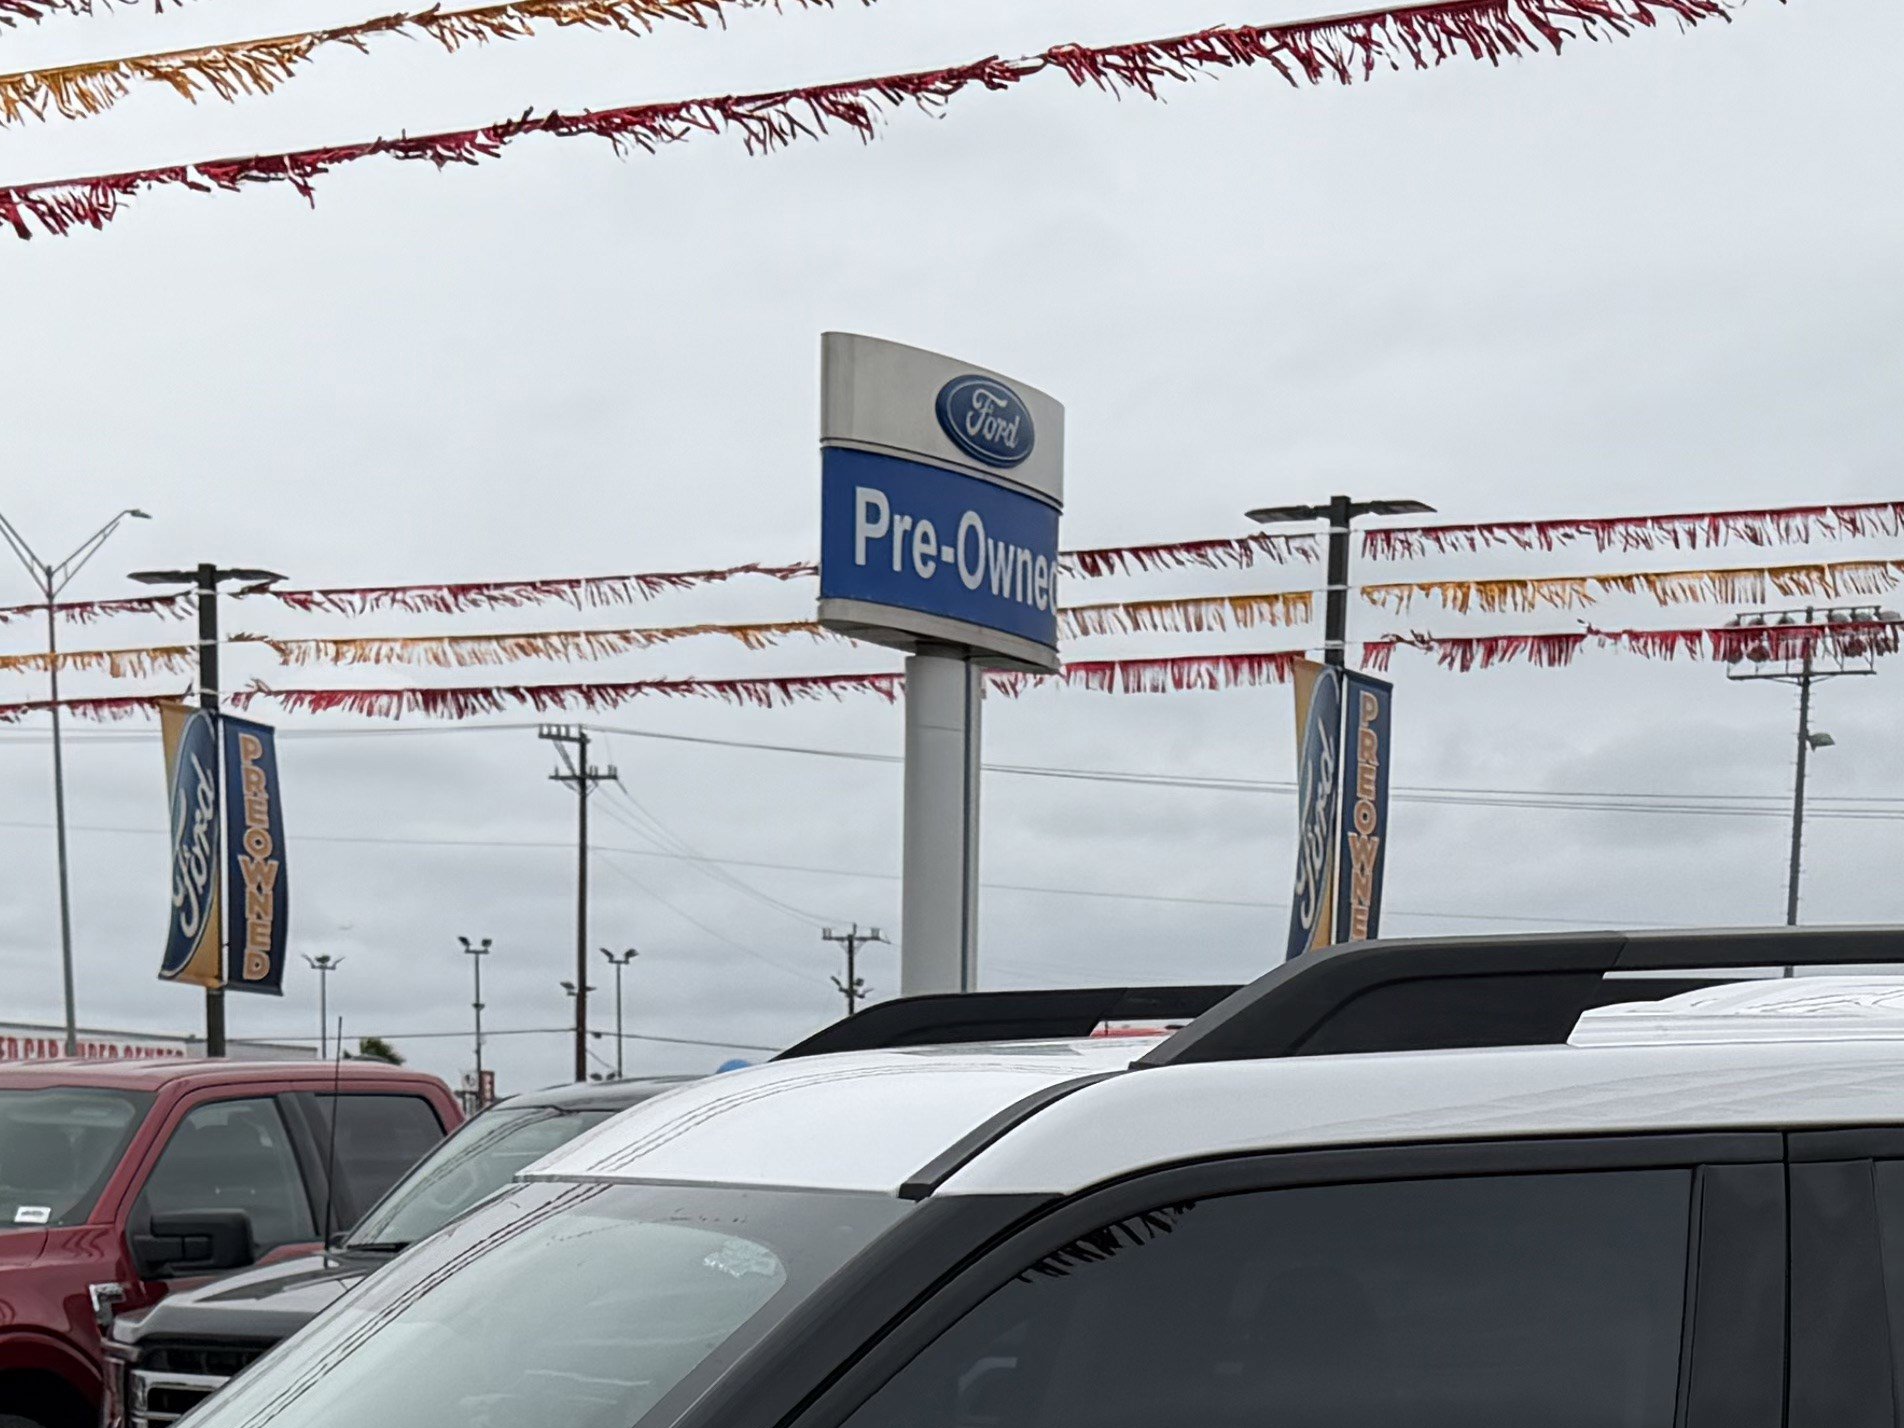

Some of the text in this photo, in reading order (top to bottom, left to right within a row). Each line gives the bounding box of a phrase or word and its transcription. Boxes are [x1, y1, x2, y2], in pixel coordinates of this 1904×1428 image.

[965, 388, 1023, 450] Ford
[172, 752, 215, 938] Ford
[237, 732, 280, 981] PREOWNED
[1296, 716, 1335, 930] Ford
[1347, 690, 1380, 941] PREOWNE
